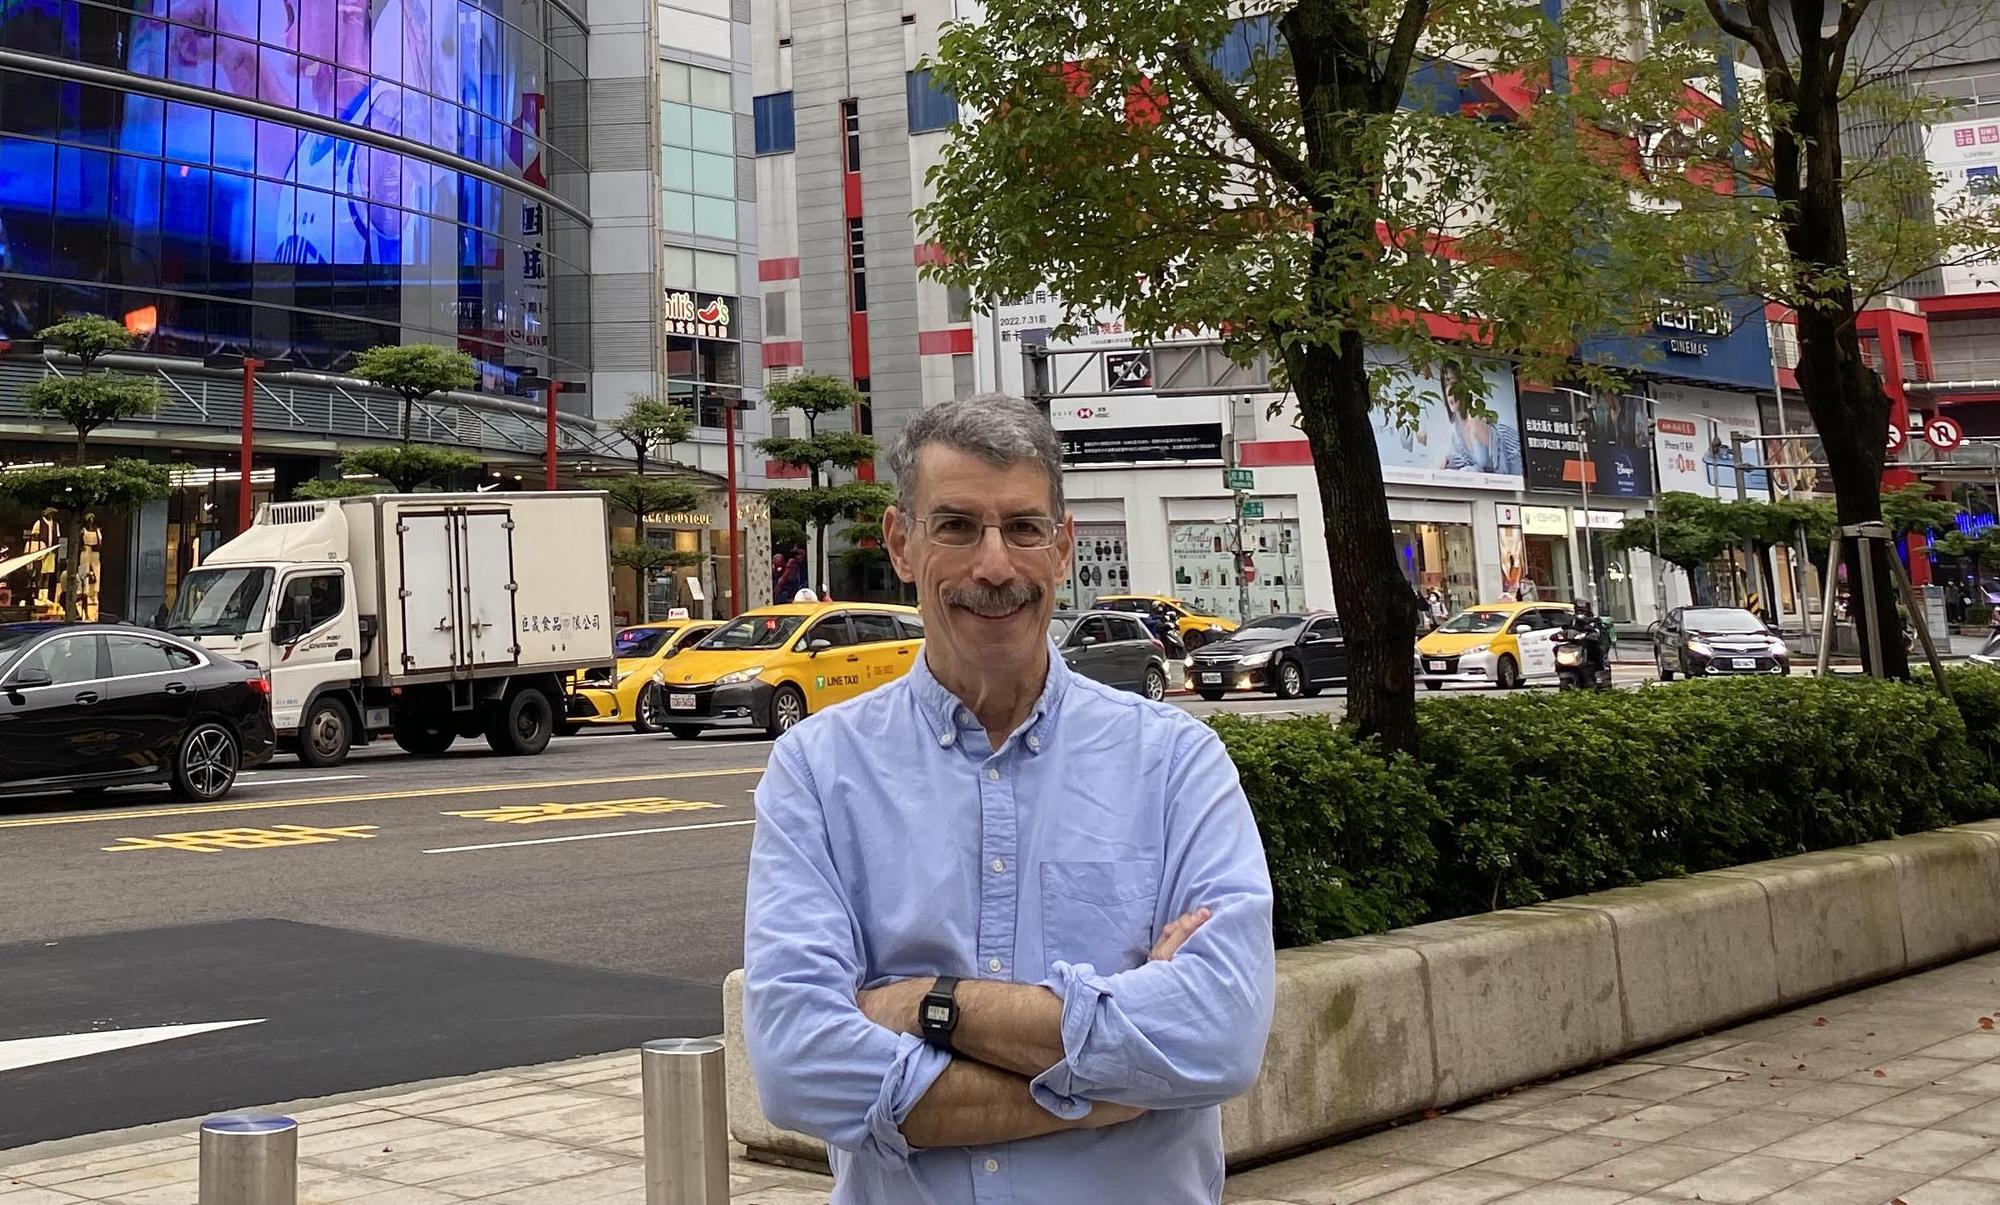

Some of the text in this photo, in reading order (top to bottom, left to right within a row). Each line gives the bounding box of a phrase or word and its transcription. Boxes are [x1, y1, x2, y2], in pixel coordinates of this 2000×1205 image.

[1670, 339, 1709, 356] CINEMAS
[664, 513, 711, 525] BOUTIQUE
[827, 675, 843, 686] LINE
[844, 674, 859, 685] TAXI
